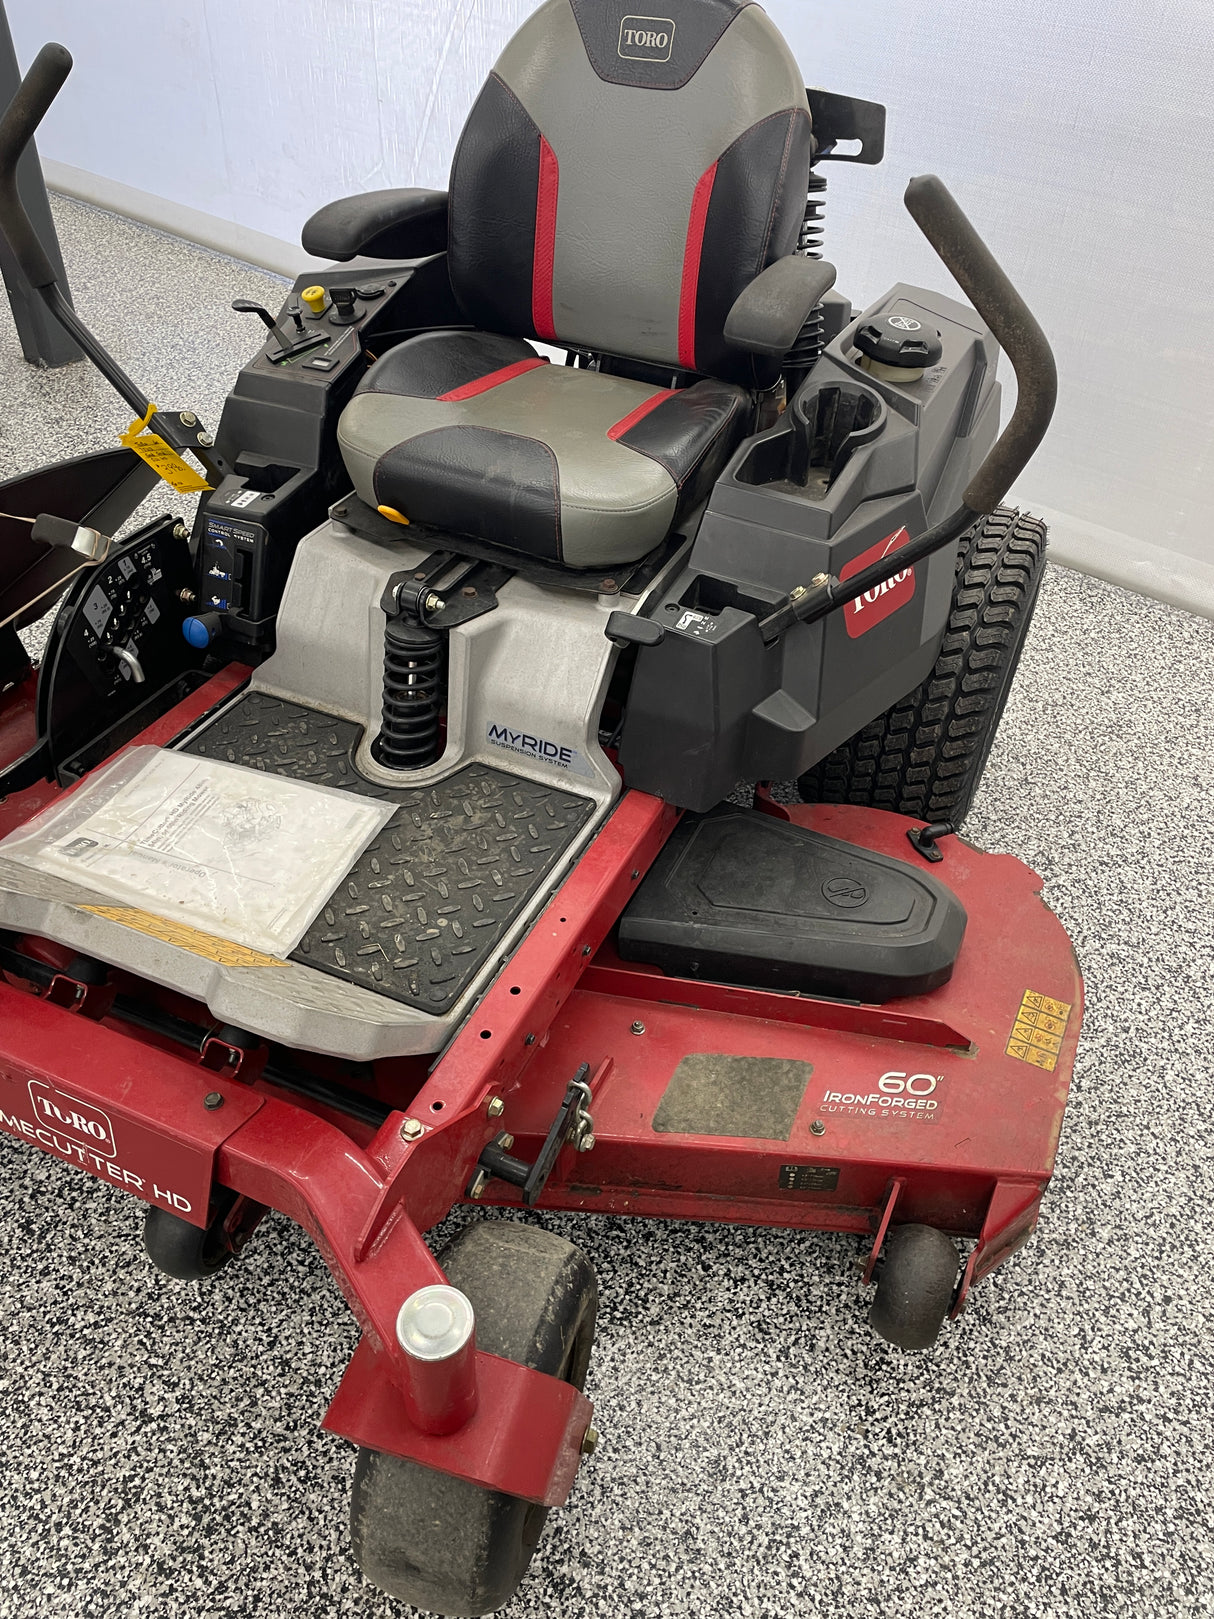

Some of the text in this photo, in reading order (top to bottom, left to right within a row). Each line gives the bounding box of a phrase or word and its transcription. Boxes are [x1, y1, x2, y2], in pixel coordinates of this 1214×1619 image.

[624, 29, 668, 48] TORO
[207, 527, 231, 538] CONTROL
[208, 522, 255, 538] SMART SPEED
[141, 554, 152, 564] 4.5
[107, 575, 113, 584] 2
[490, 739, 569, 769] SUSPENSION SYSTEM
[878, 1071, 945, 1096] 60"
[819, 1104, 935, 1120] CUTTING SYSTEM
[152, 1183, 192, 1213] HD
